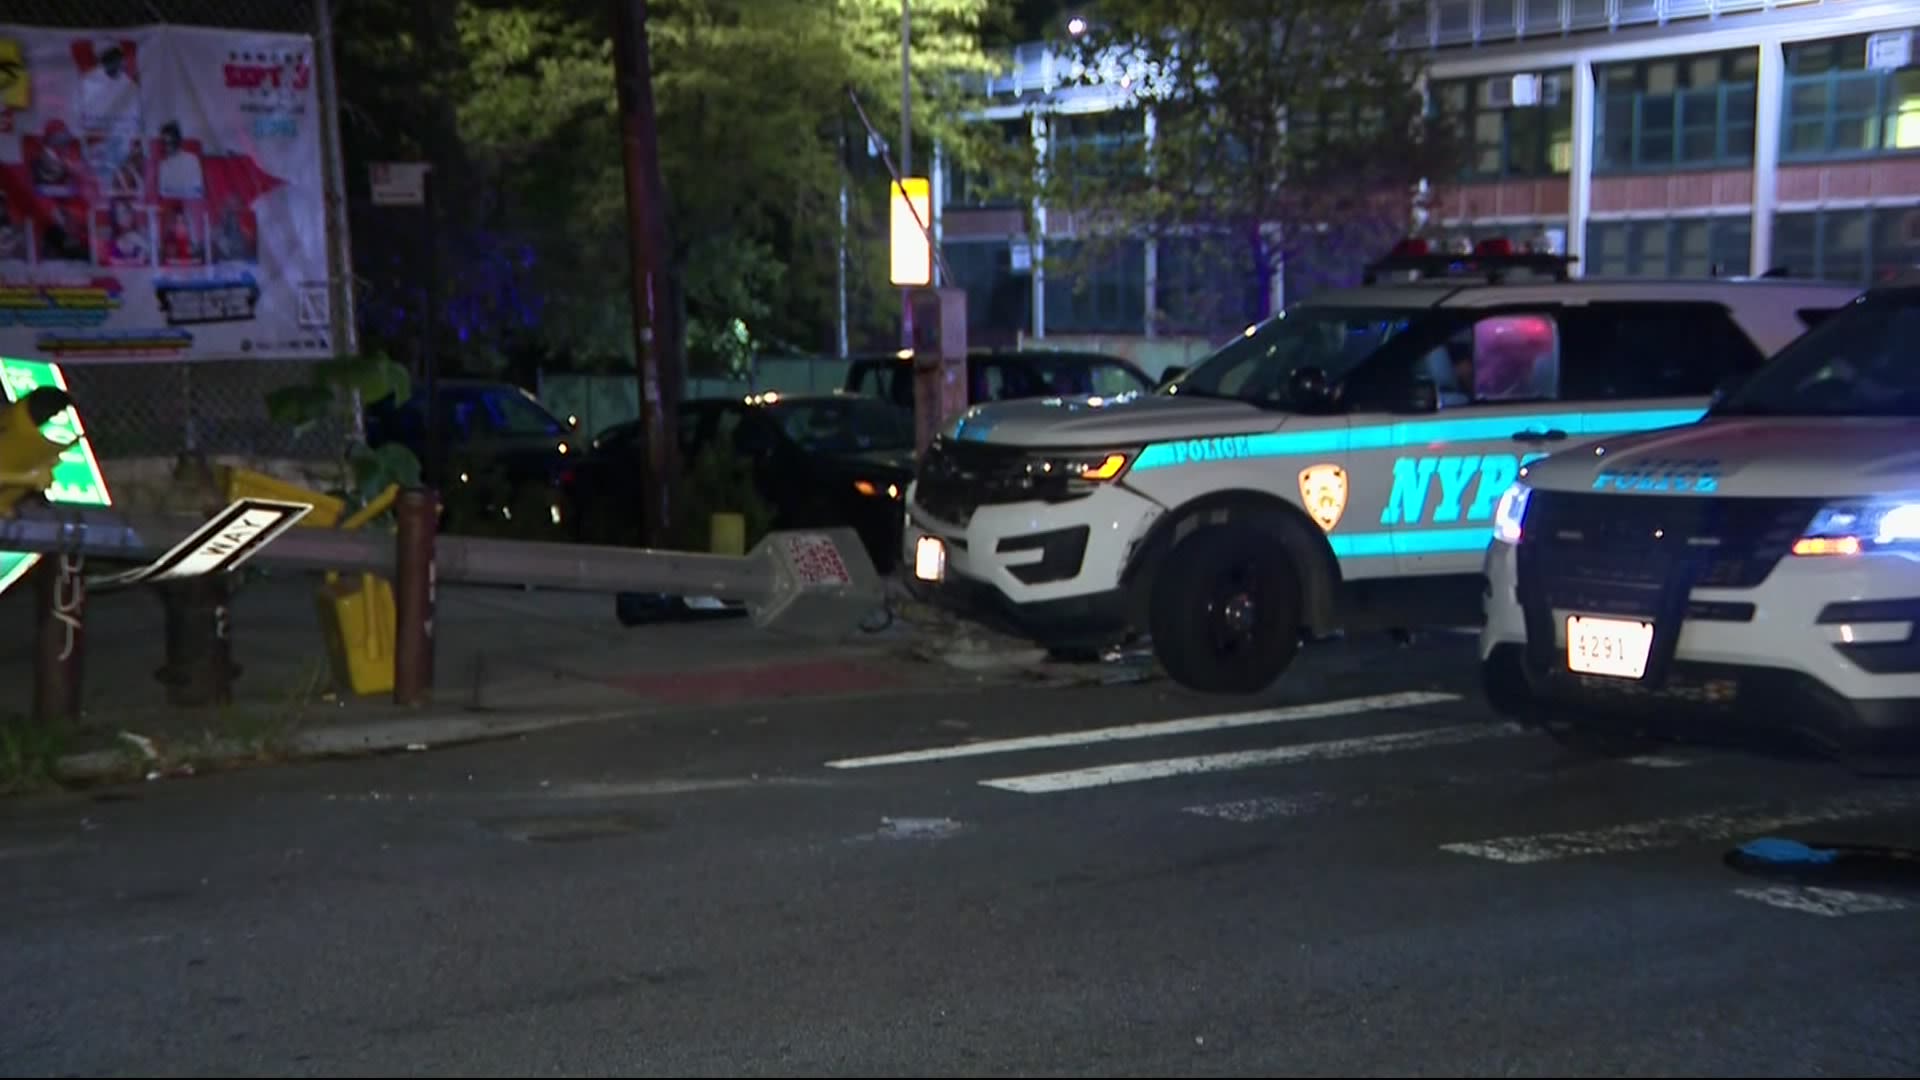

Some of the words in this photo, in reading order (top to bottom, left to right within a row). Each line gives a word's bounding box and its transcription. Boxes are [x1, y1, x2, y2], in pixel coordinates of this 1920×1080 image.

[1174, 436, 1249, 463] POLICE
[1380, 455, 1550, 524] NYP
[200, 518, 260, 555] WAY
[1578, 635, 1625, 661] 4291
